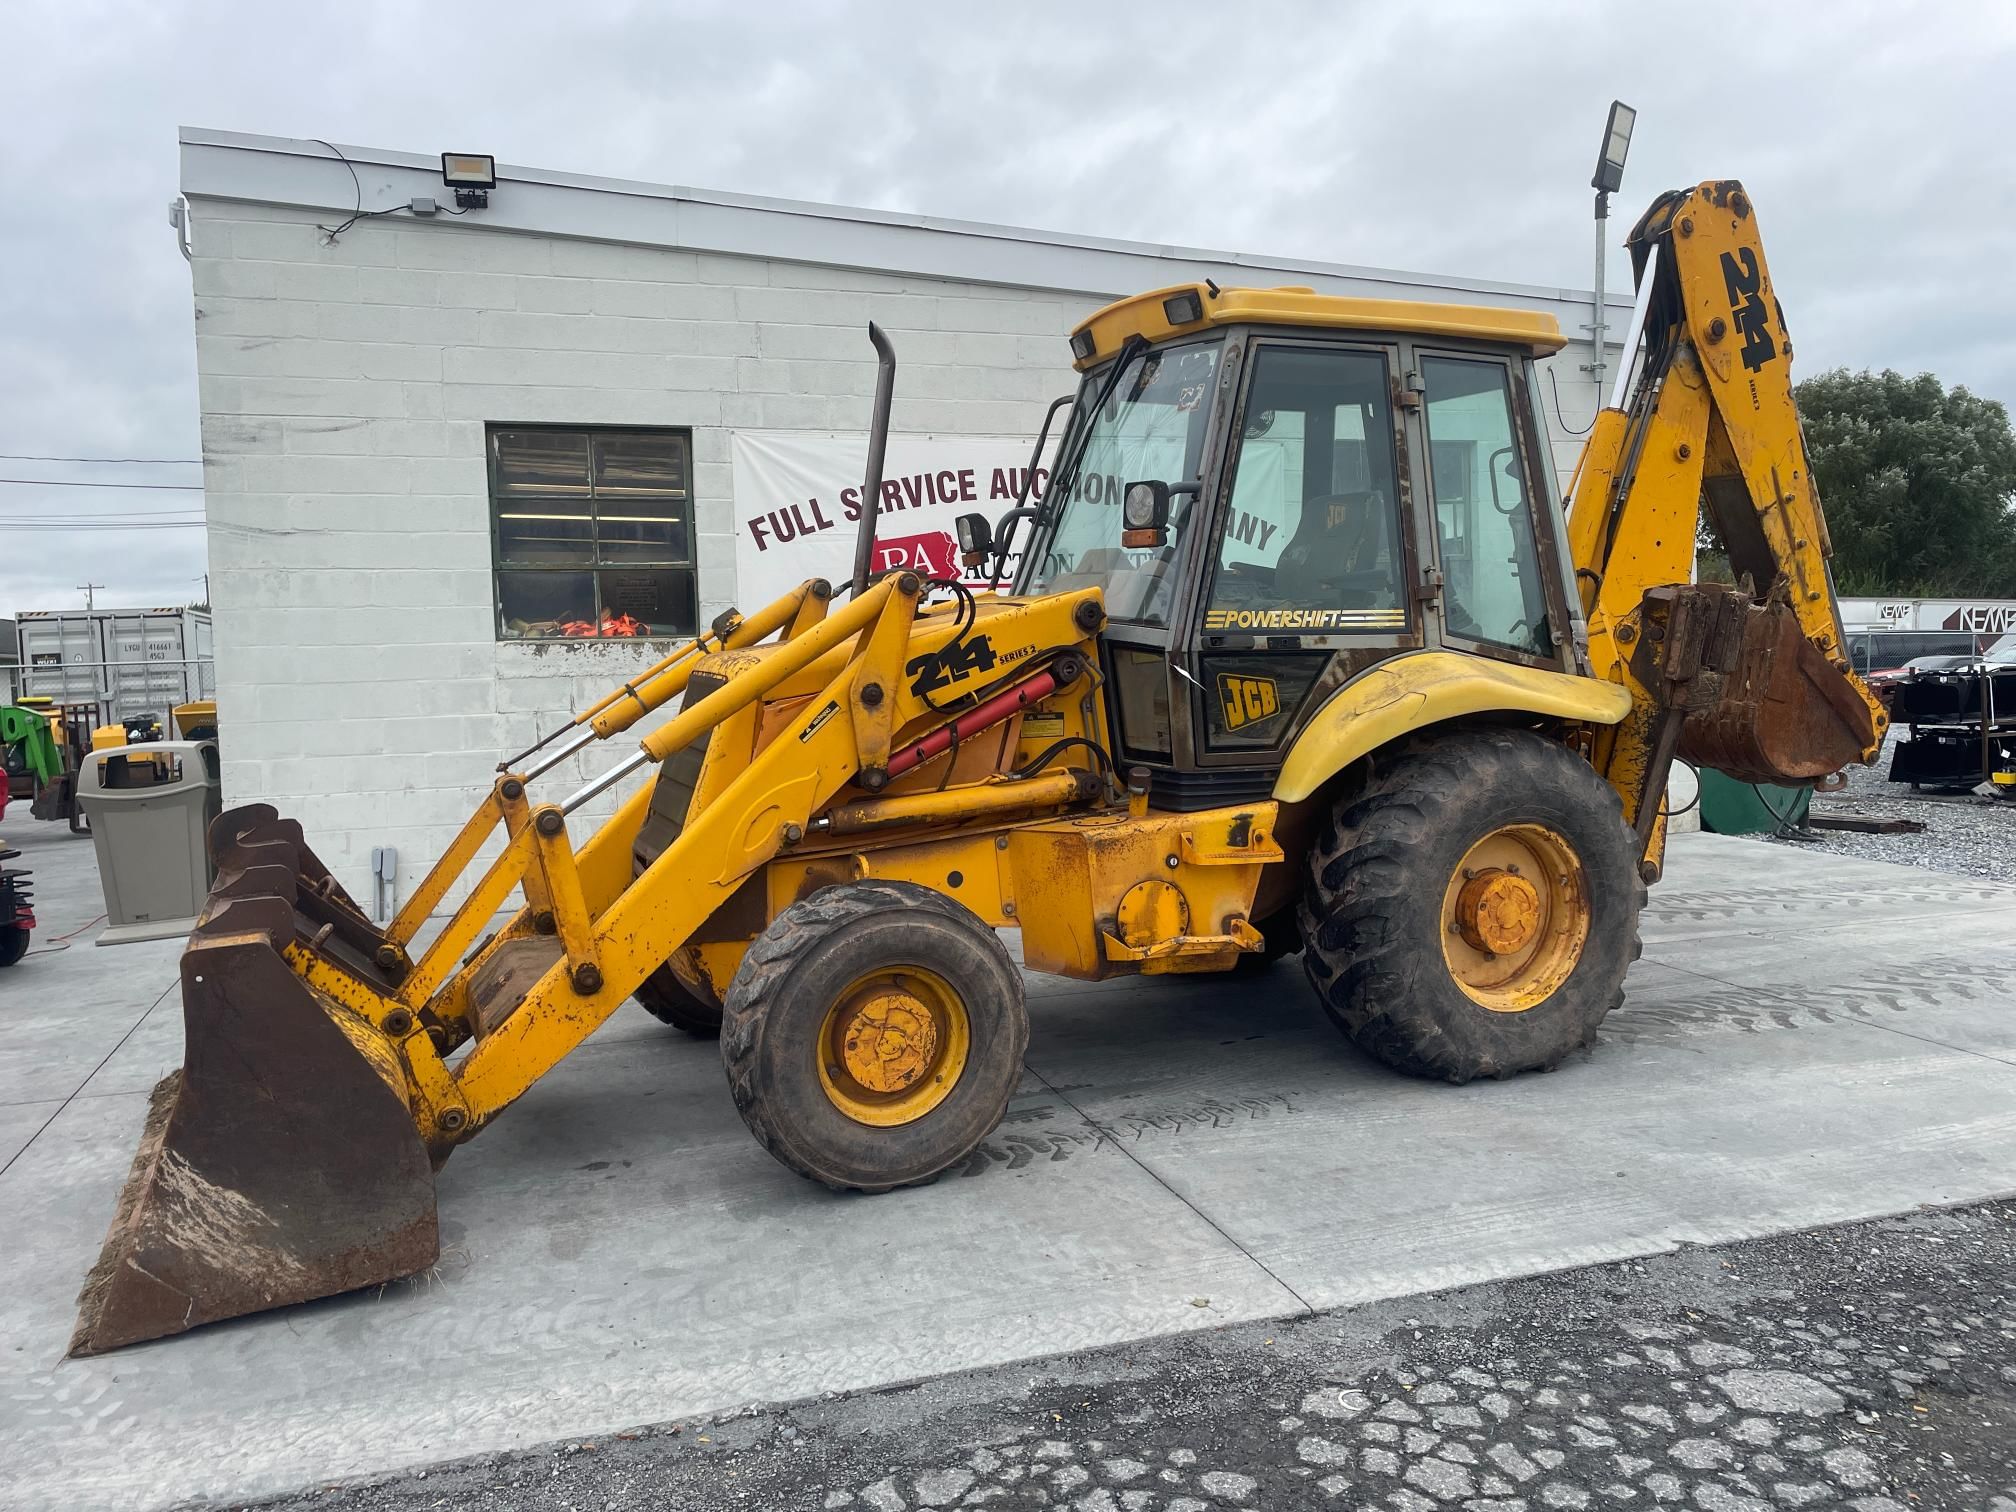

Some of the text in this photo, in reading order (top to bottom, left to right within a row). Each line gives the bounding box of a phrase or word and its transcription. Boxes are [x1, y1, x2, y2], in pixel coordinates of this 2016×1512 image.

[748, 467, 1122, 551] FULL SRVICE AUCION
[880, 543, 938, 575] PA
[1224, 610, 1341, 628] POWERSHIFT
[905, 634, 1037, 698] 214 SERIES 2
[1226, 677, 1277, 728] JCB
